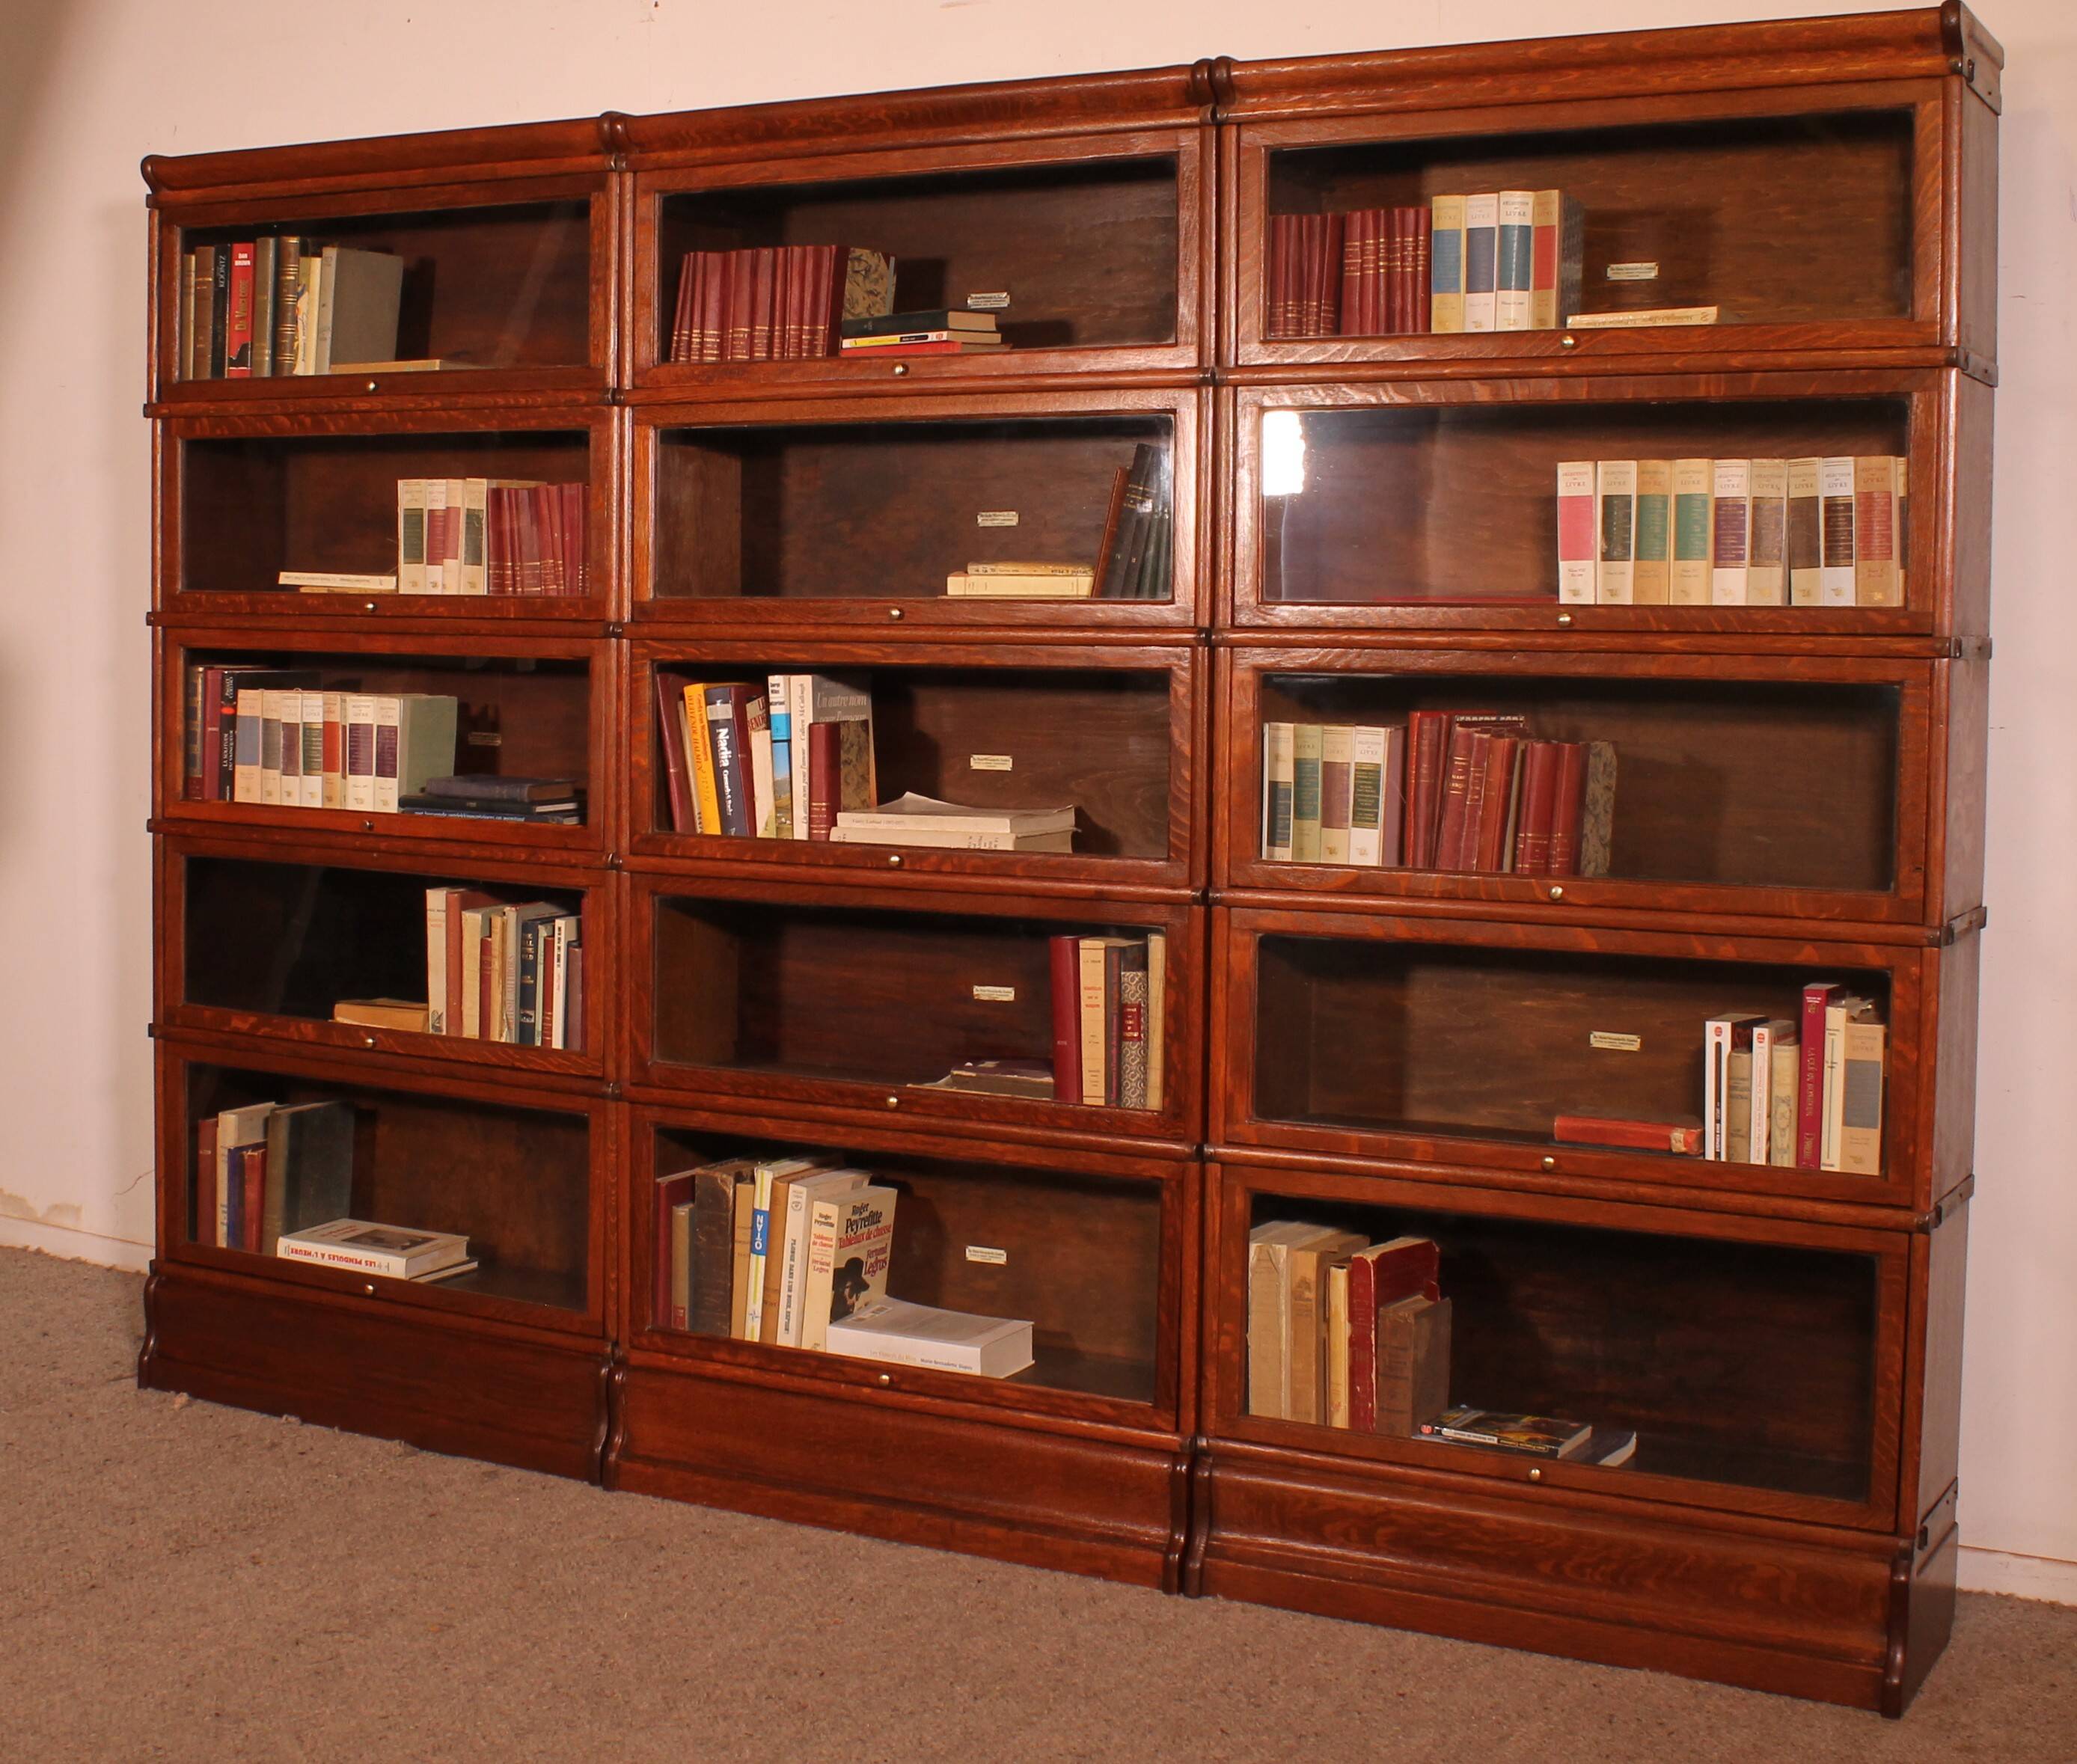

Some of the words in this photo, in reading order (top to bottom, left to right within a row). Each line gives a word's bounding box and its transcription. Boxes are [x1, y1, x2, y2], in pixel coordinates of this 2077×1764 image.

[218, 254, 226, 288] KOONTZ
[828, 695, 848, 707] autre
[849, 695, 867, 706] nom
[694, 738, 703, 771] HALMEN
[716, 727, 732, 768] Nadia
[852, 1203, 869, 1216] Roger
[845, 1210, 883, 1235] Peyrefitte
[839, 1234, 864, 1249] Tableaux
[864, 1228, 872, 1241] de
[872, 1223, 892, 1239] chasse
[290, 1247, 319, 1257] L'HEURE
[328, 1254, 363, 1265] PENDULES
[867, 1243, 888, 1259] Fernand
[813, 1265, 829, 1273] Legros
[864, 1257, 887, 1278] Legros
